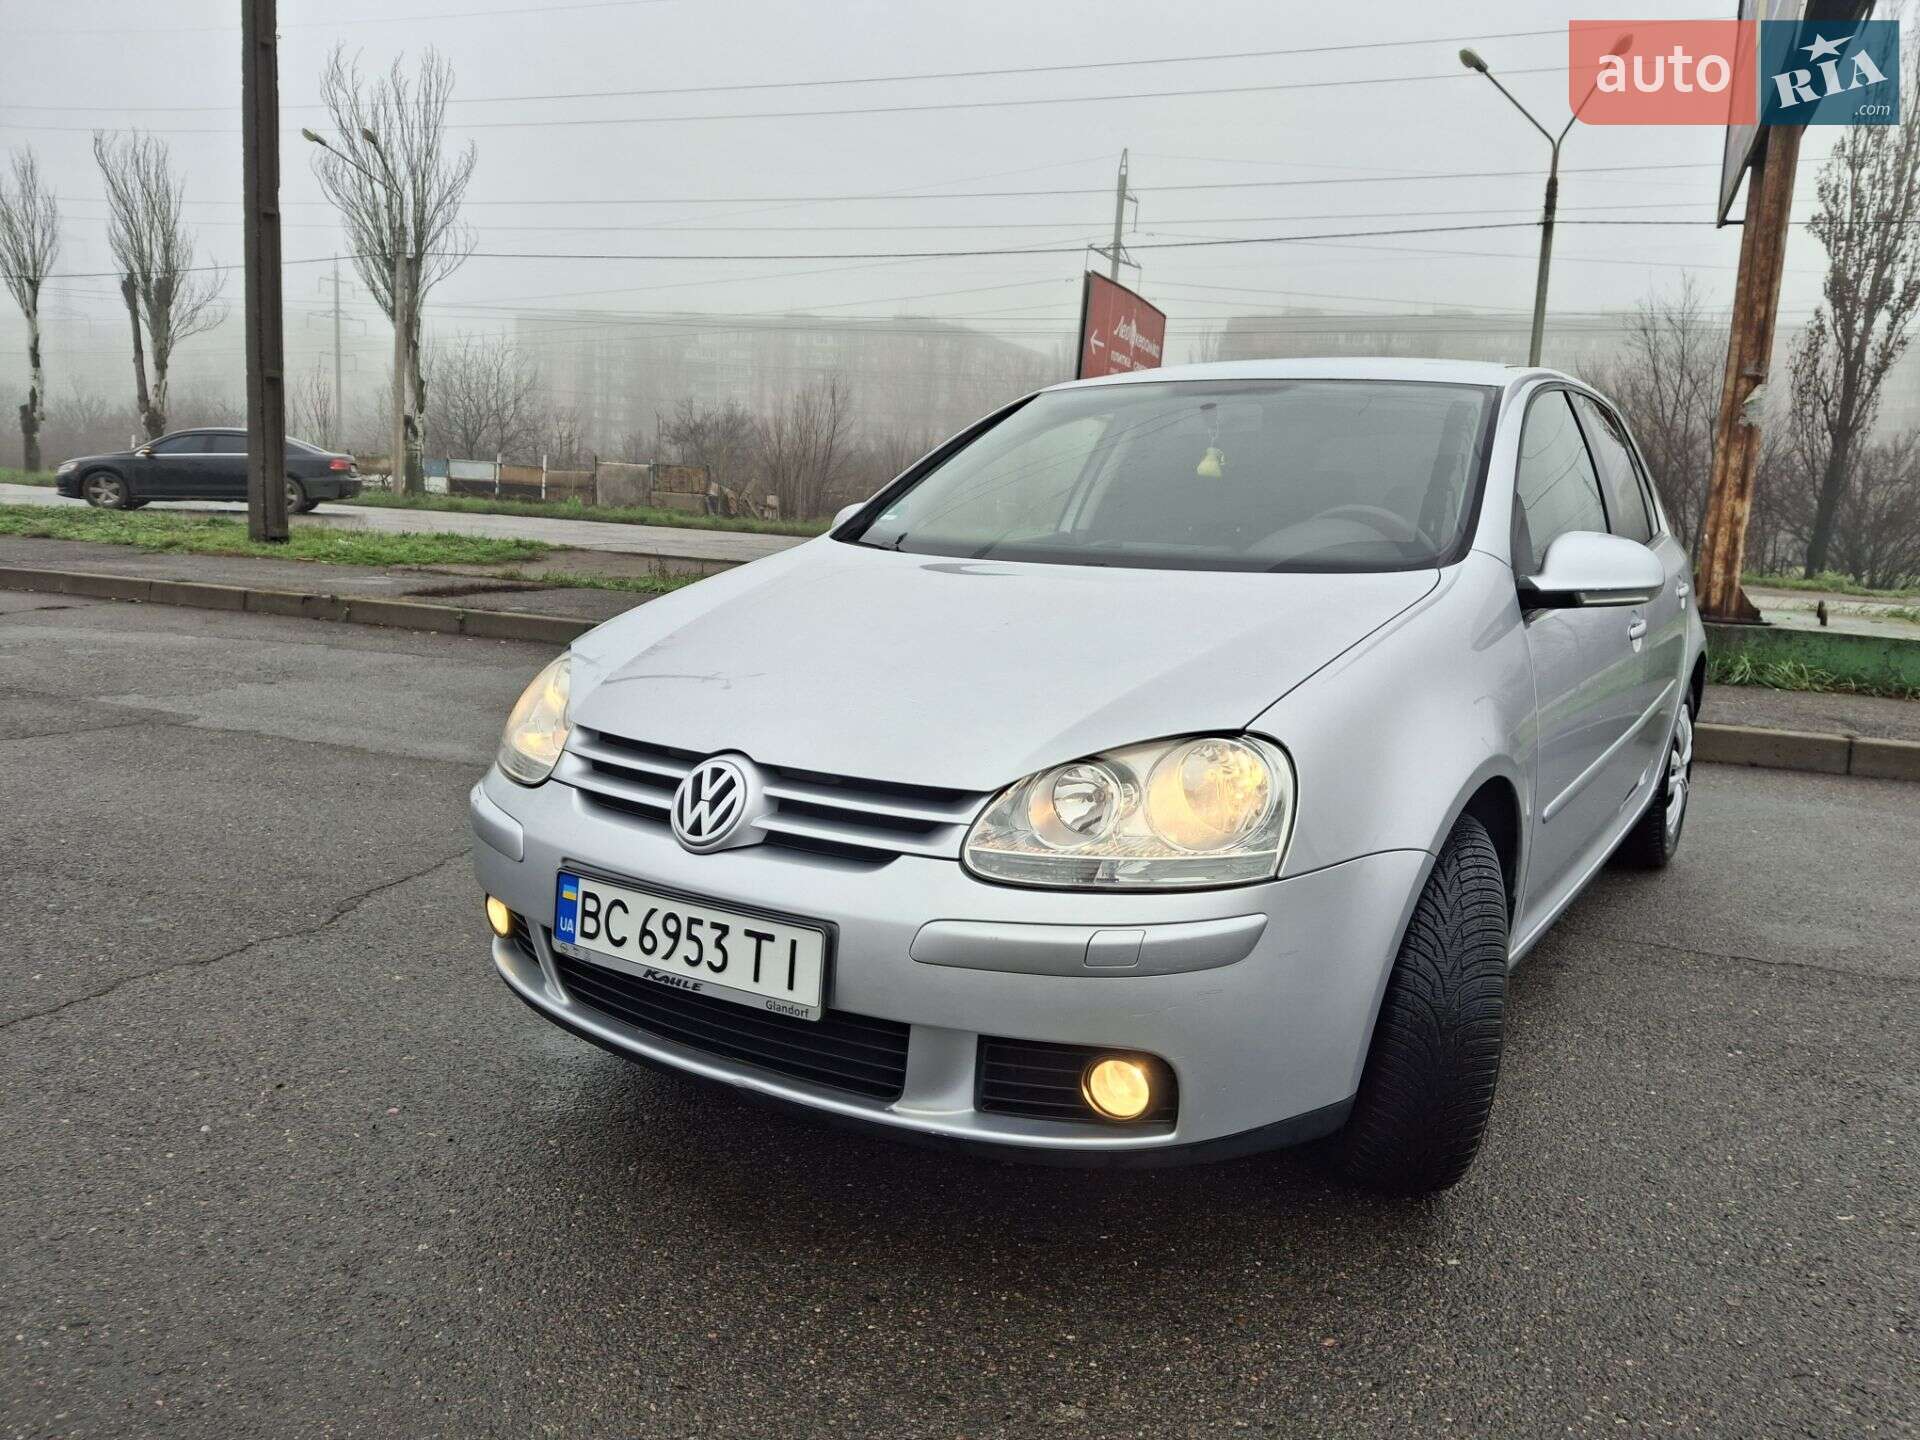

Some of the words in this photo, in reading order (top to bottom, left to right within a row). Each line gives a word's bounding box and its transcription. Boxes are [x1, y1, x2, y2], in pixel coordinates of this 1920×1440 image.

[559, 916, 575, 934] UA
[580, 890, 629, 948] BC
[638, 907, 730, 974] 6953
[744, 928, 798, 992] TI
[765, 999, 810, 1019] Glandorf
